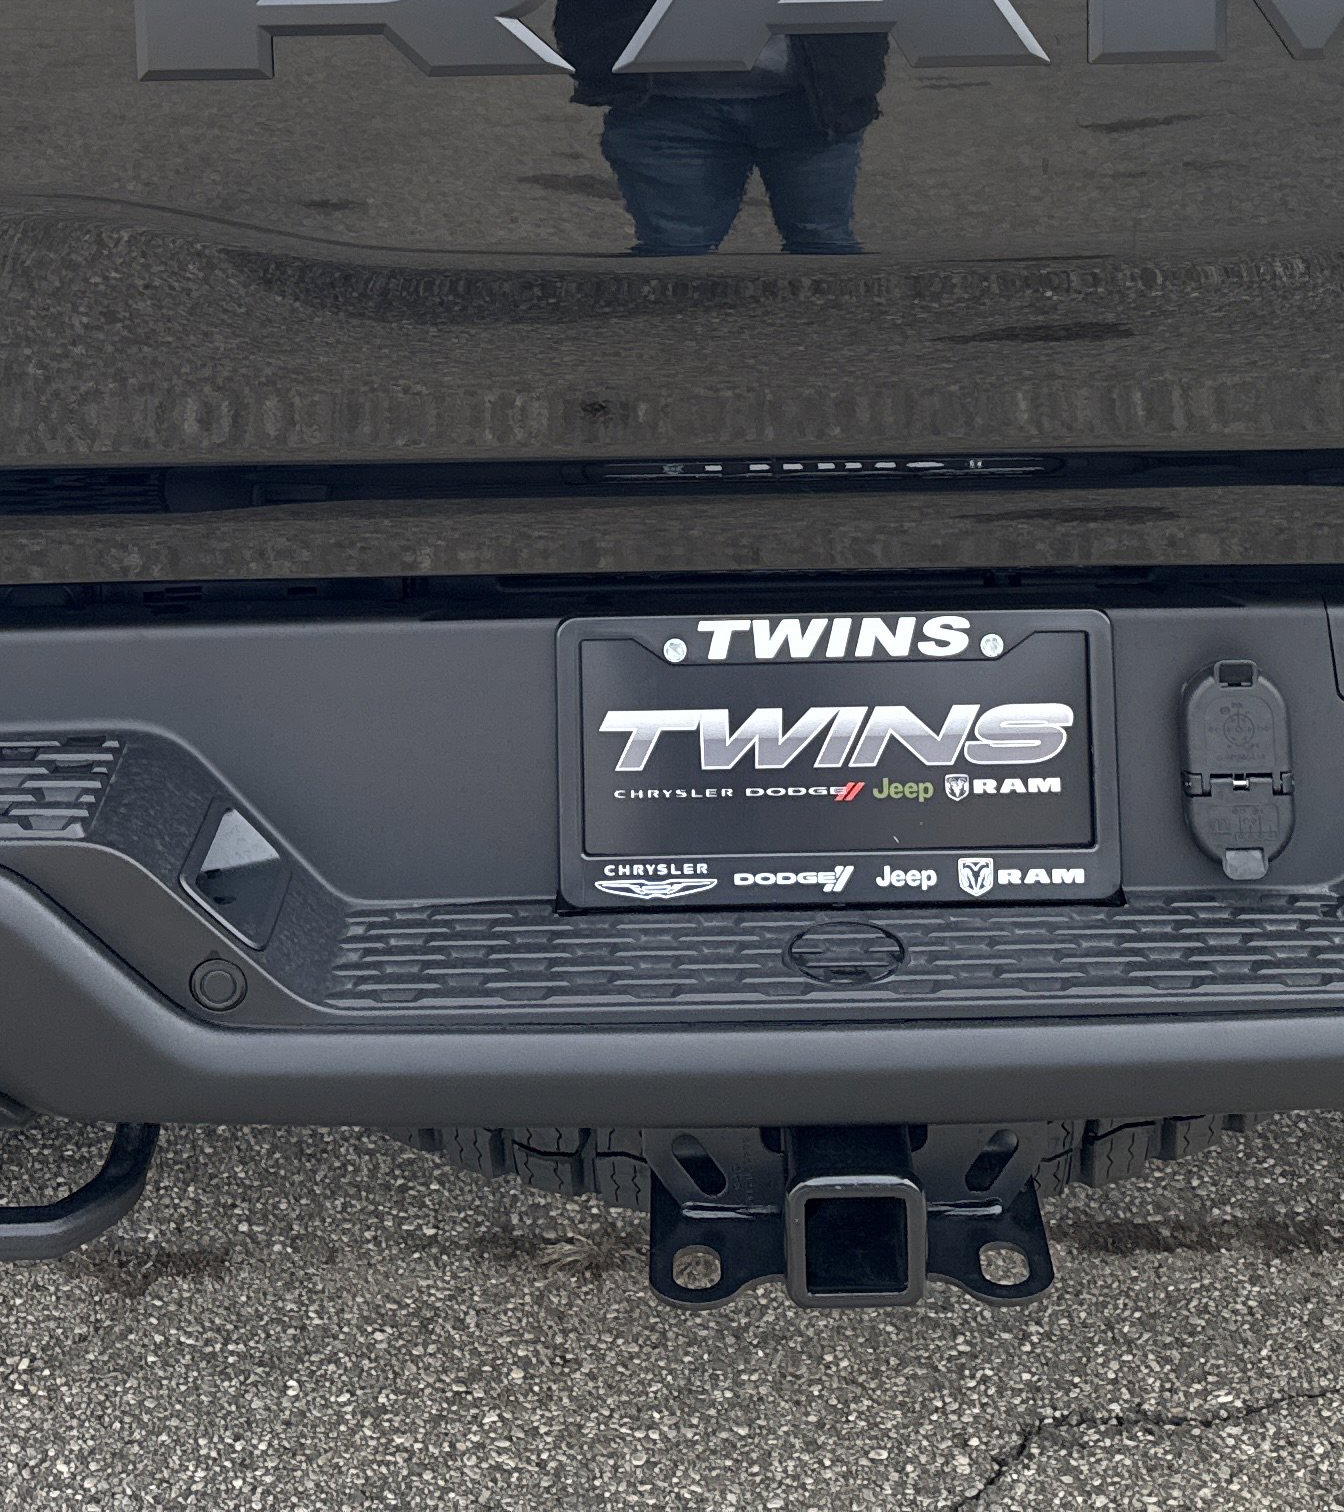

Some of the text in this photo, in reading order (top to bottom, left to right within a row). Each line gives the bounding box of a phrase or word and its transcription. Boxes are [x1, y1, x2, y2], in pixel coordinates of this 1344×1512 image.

[697, 615, 971, 660] TWINS
[598, 702, 1074, 772] TWINS
[613, 776, 1062, 803] CHRYSLER DODGE Jeep RAM
[603, 863, 1086, 890] CHRYSLER DODGE Jeep RAM
